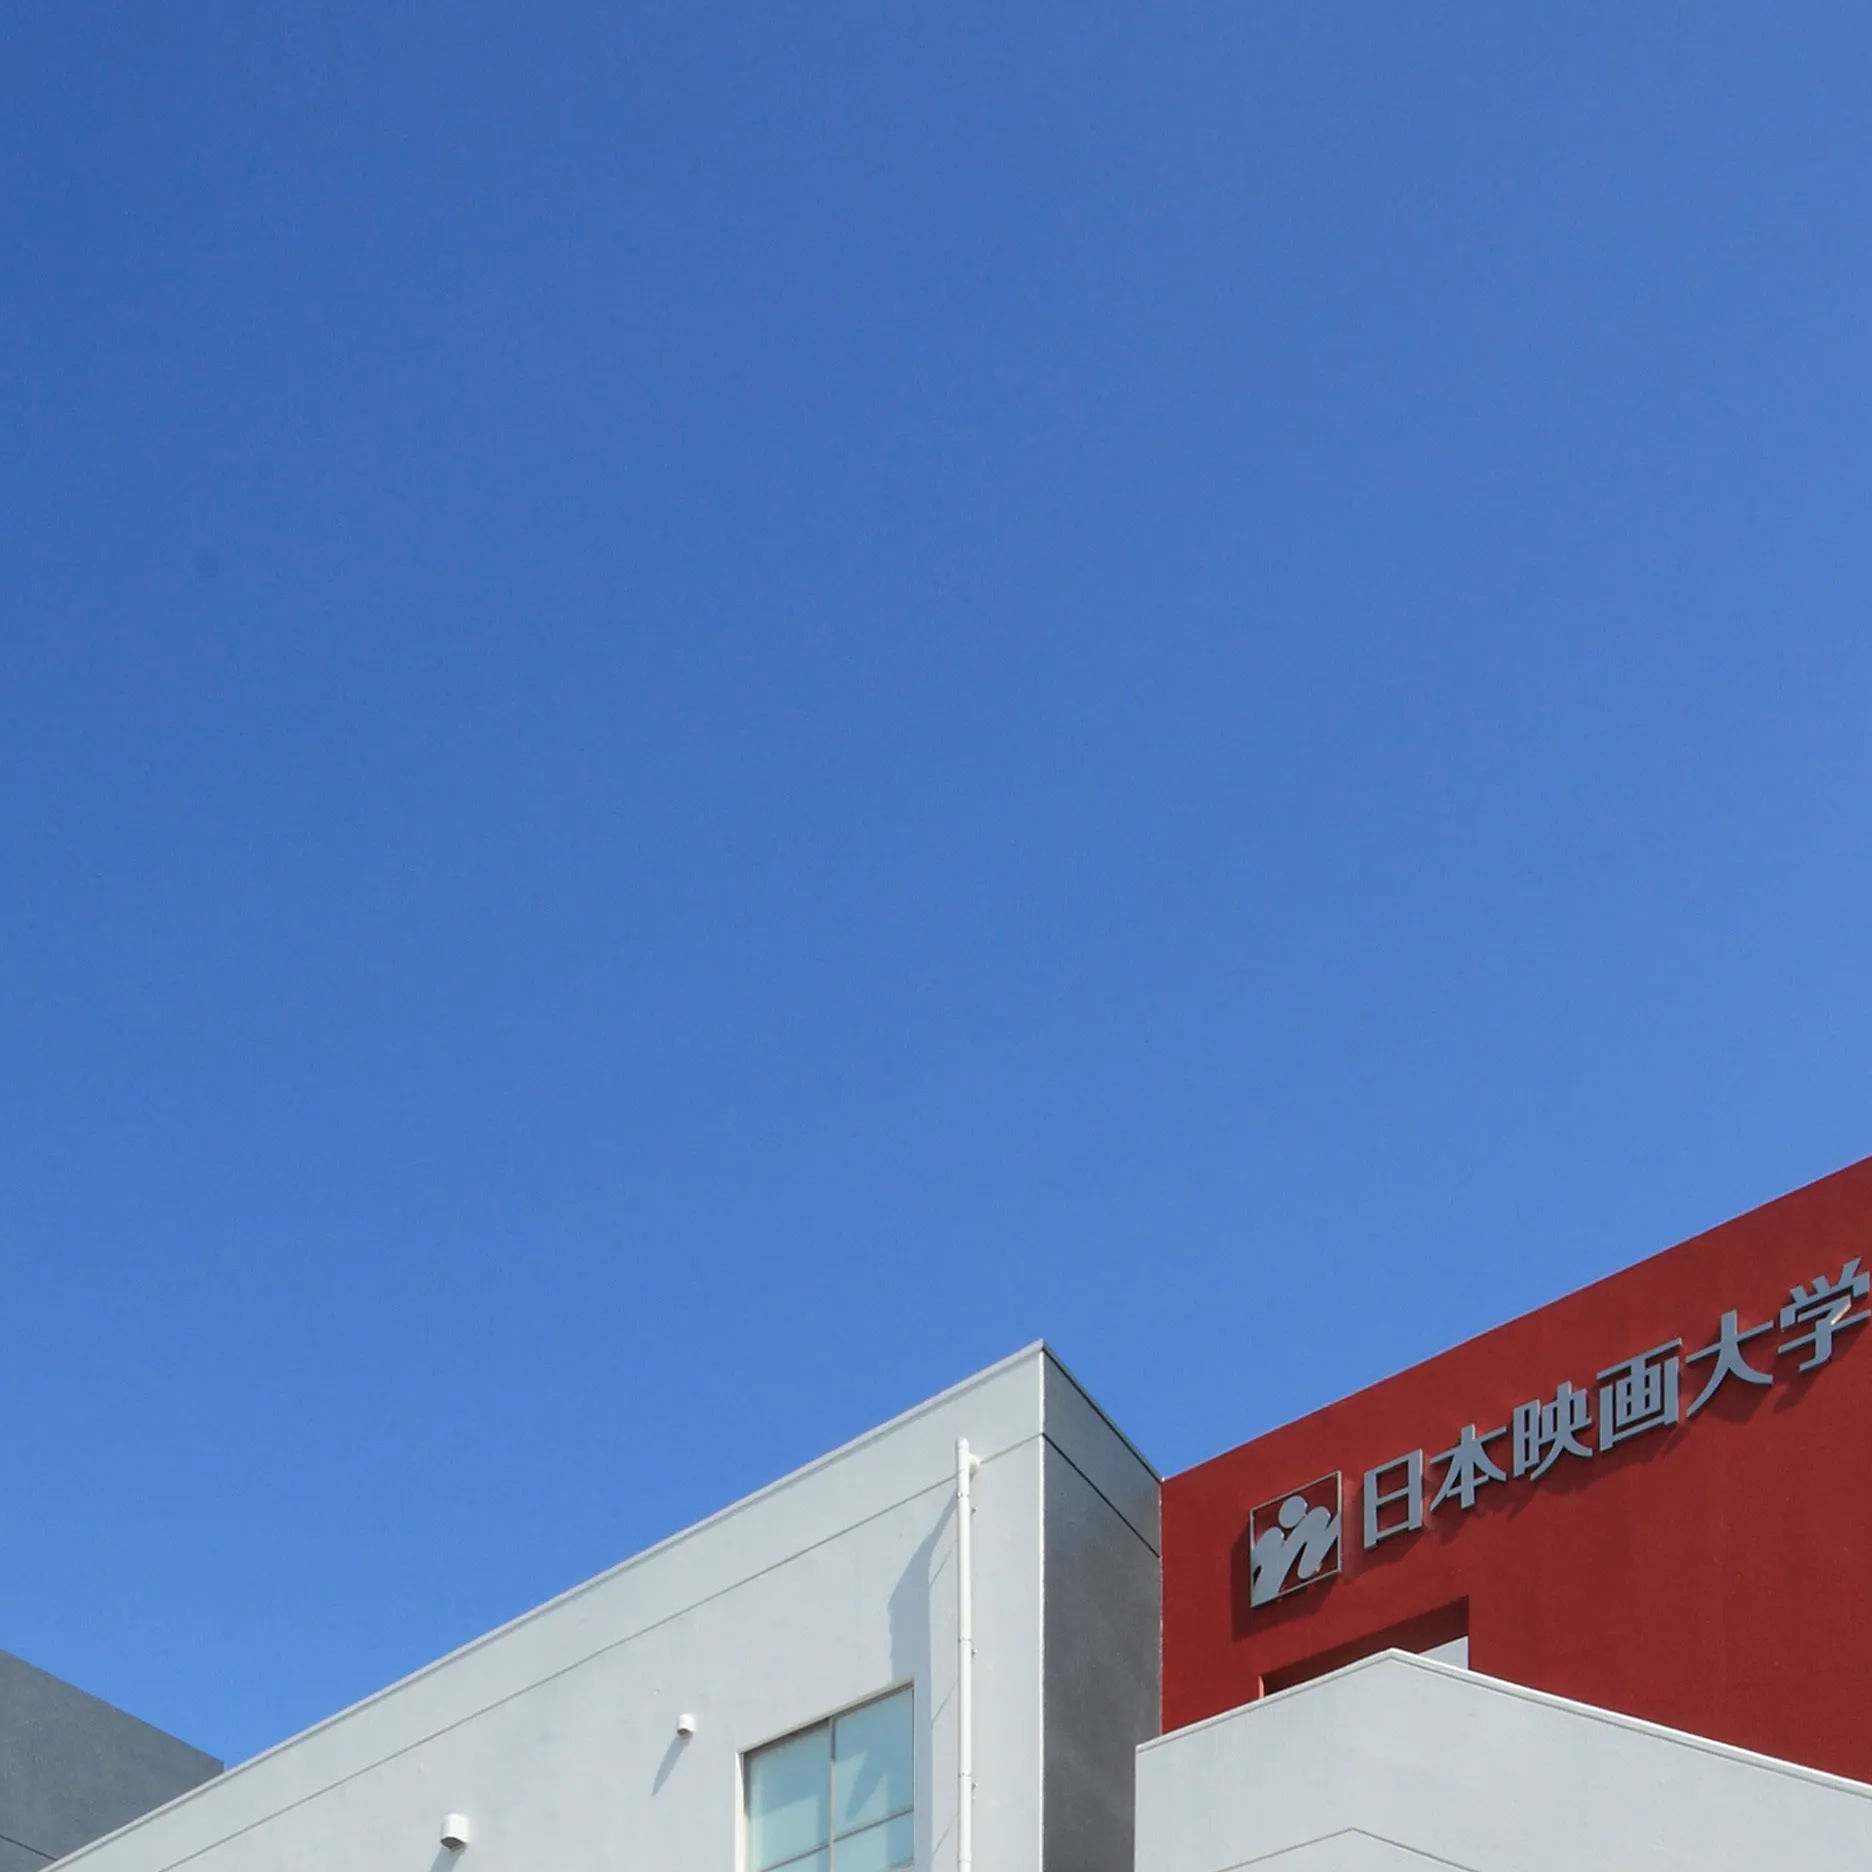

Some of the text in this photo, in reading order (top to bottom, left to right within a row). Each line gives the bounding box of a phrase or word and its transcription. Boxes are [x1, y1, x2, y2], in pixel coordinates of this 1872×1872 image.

[1363, 1257, 1872, 1549] 日本映画大学
